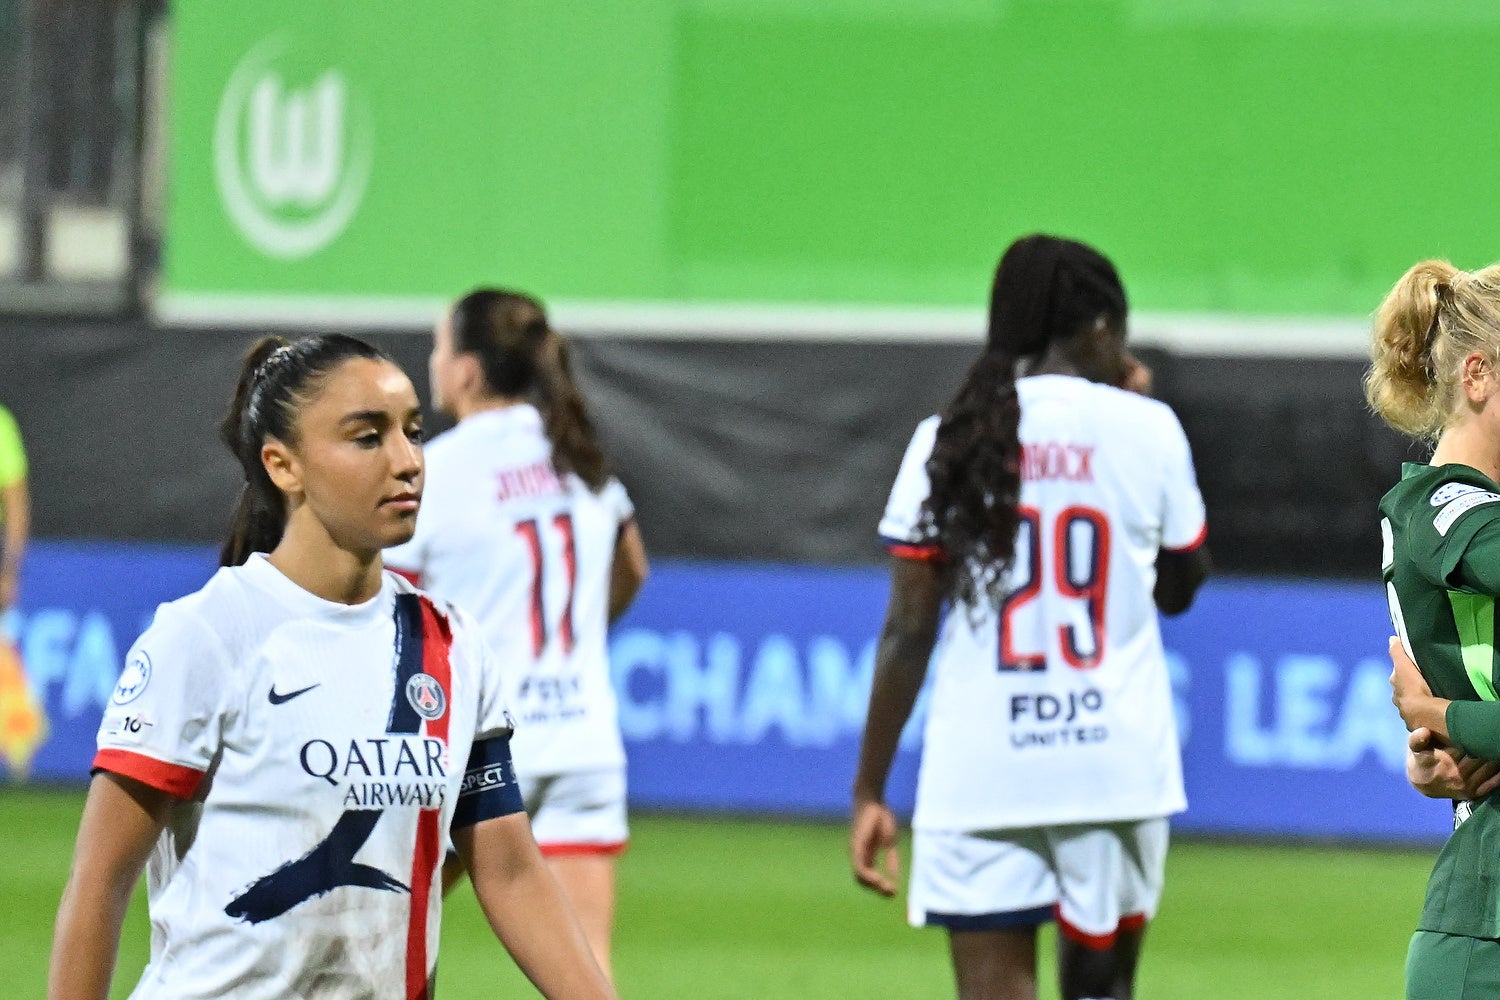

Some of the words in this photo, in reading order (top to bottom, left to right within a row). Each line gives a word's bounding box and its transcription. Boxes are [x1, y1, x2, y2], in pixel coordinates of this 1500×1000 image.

[1018, 441, 1095, 482] BOCK
[513, 512, 578, 662] 11
[997, 504, 1112, 672] 29
[0, 608, 120, 718] FA
[1224, 652, 1406, 772] LEA
[300, 738, 447, 786] QATAR
[344, 782, 447, 807] AIRWAYS
[461, 768, 503, 791] SPECT
